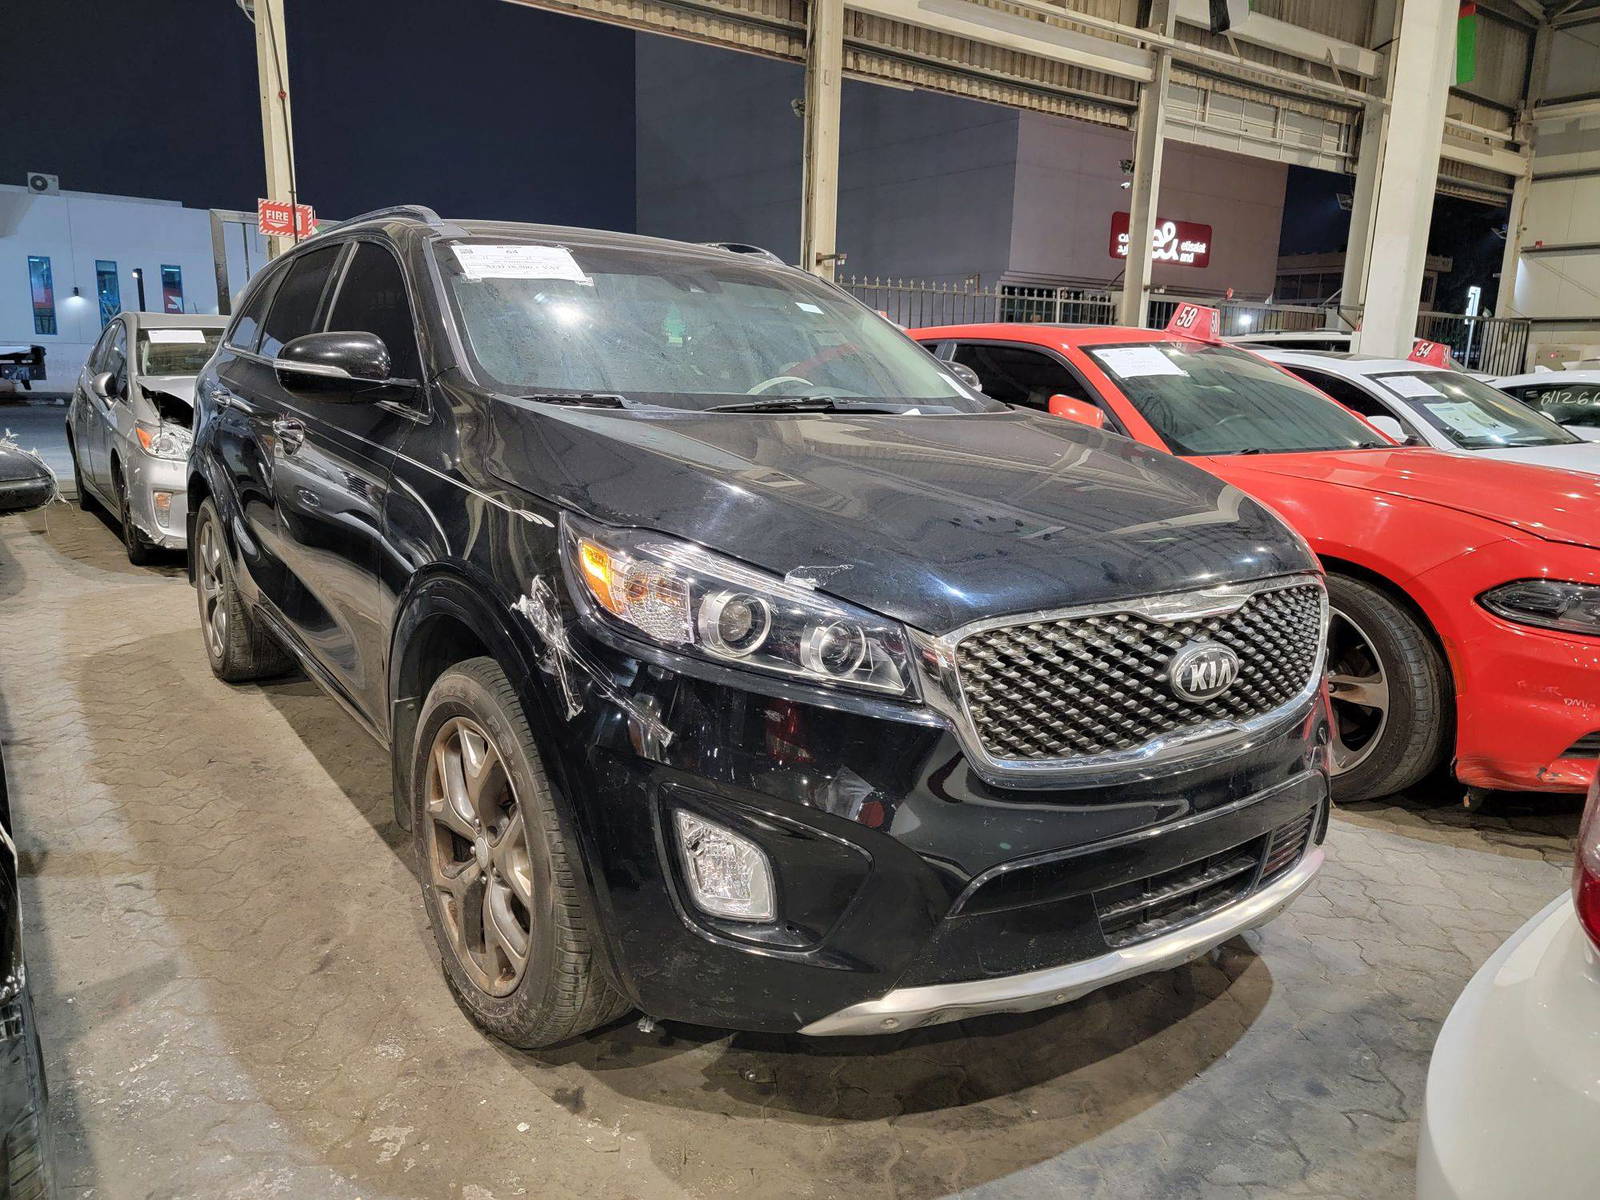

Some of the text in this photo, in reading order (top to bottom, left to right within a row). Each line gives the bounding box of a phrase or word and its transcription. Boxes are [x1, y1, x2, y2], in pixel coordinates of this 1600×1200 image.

[266, 209, 289, 221] FIRE
[1175, 306, 1198, 328] 58
[1415, 342, 1435, 358] 54
[1189, 658, 1232, 692] KIA
